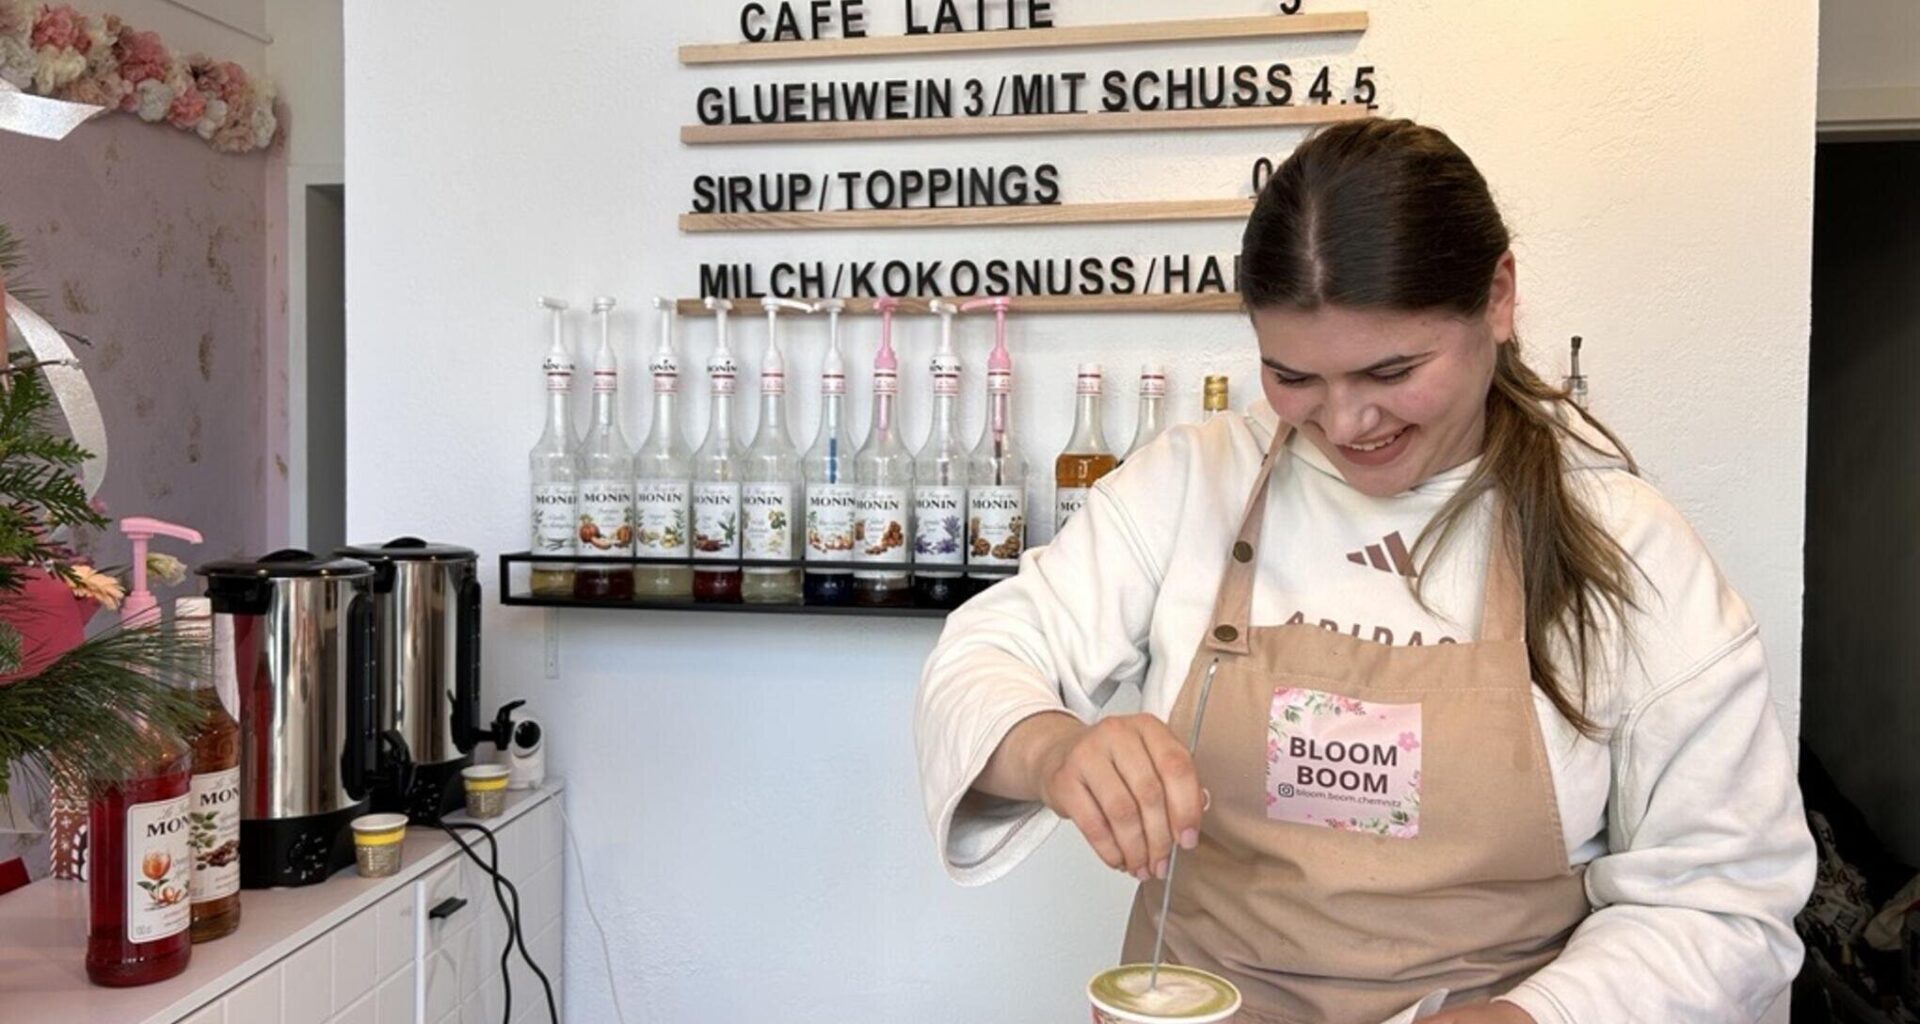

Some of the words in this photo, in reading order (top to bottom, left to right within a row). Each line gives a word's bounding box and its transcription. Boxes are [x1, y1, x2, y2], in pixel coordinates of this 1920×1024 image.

[740, 0, 866, 41] CAFE
[697, 78, 952, 125] GLUEHWEIN
[1102, 64, 1293, 112] SCHUSS
[1309, 66, 1376, 105] 4.5
[584, 493, 630, 503] MONIN
[810, 497, 855, 507] MONIN
[973, 500, 1018, 509] MONIN
[1290, 736, 1397, 767] BLOOM
[1297, 765, 1388, 794] BOOM
